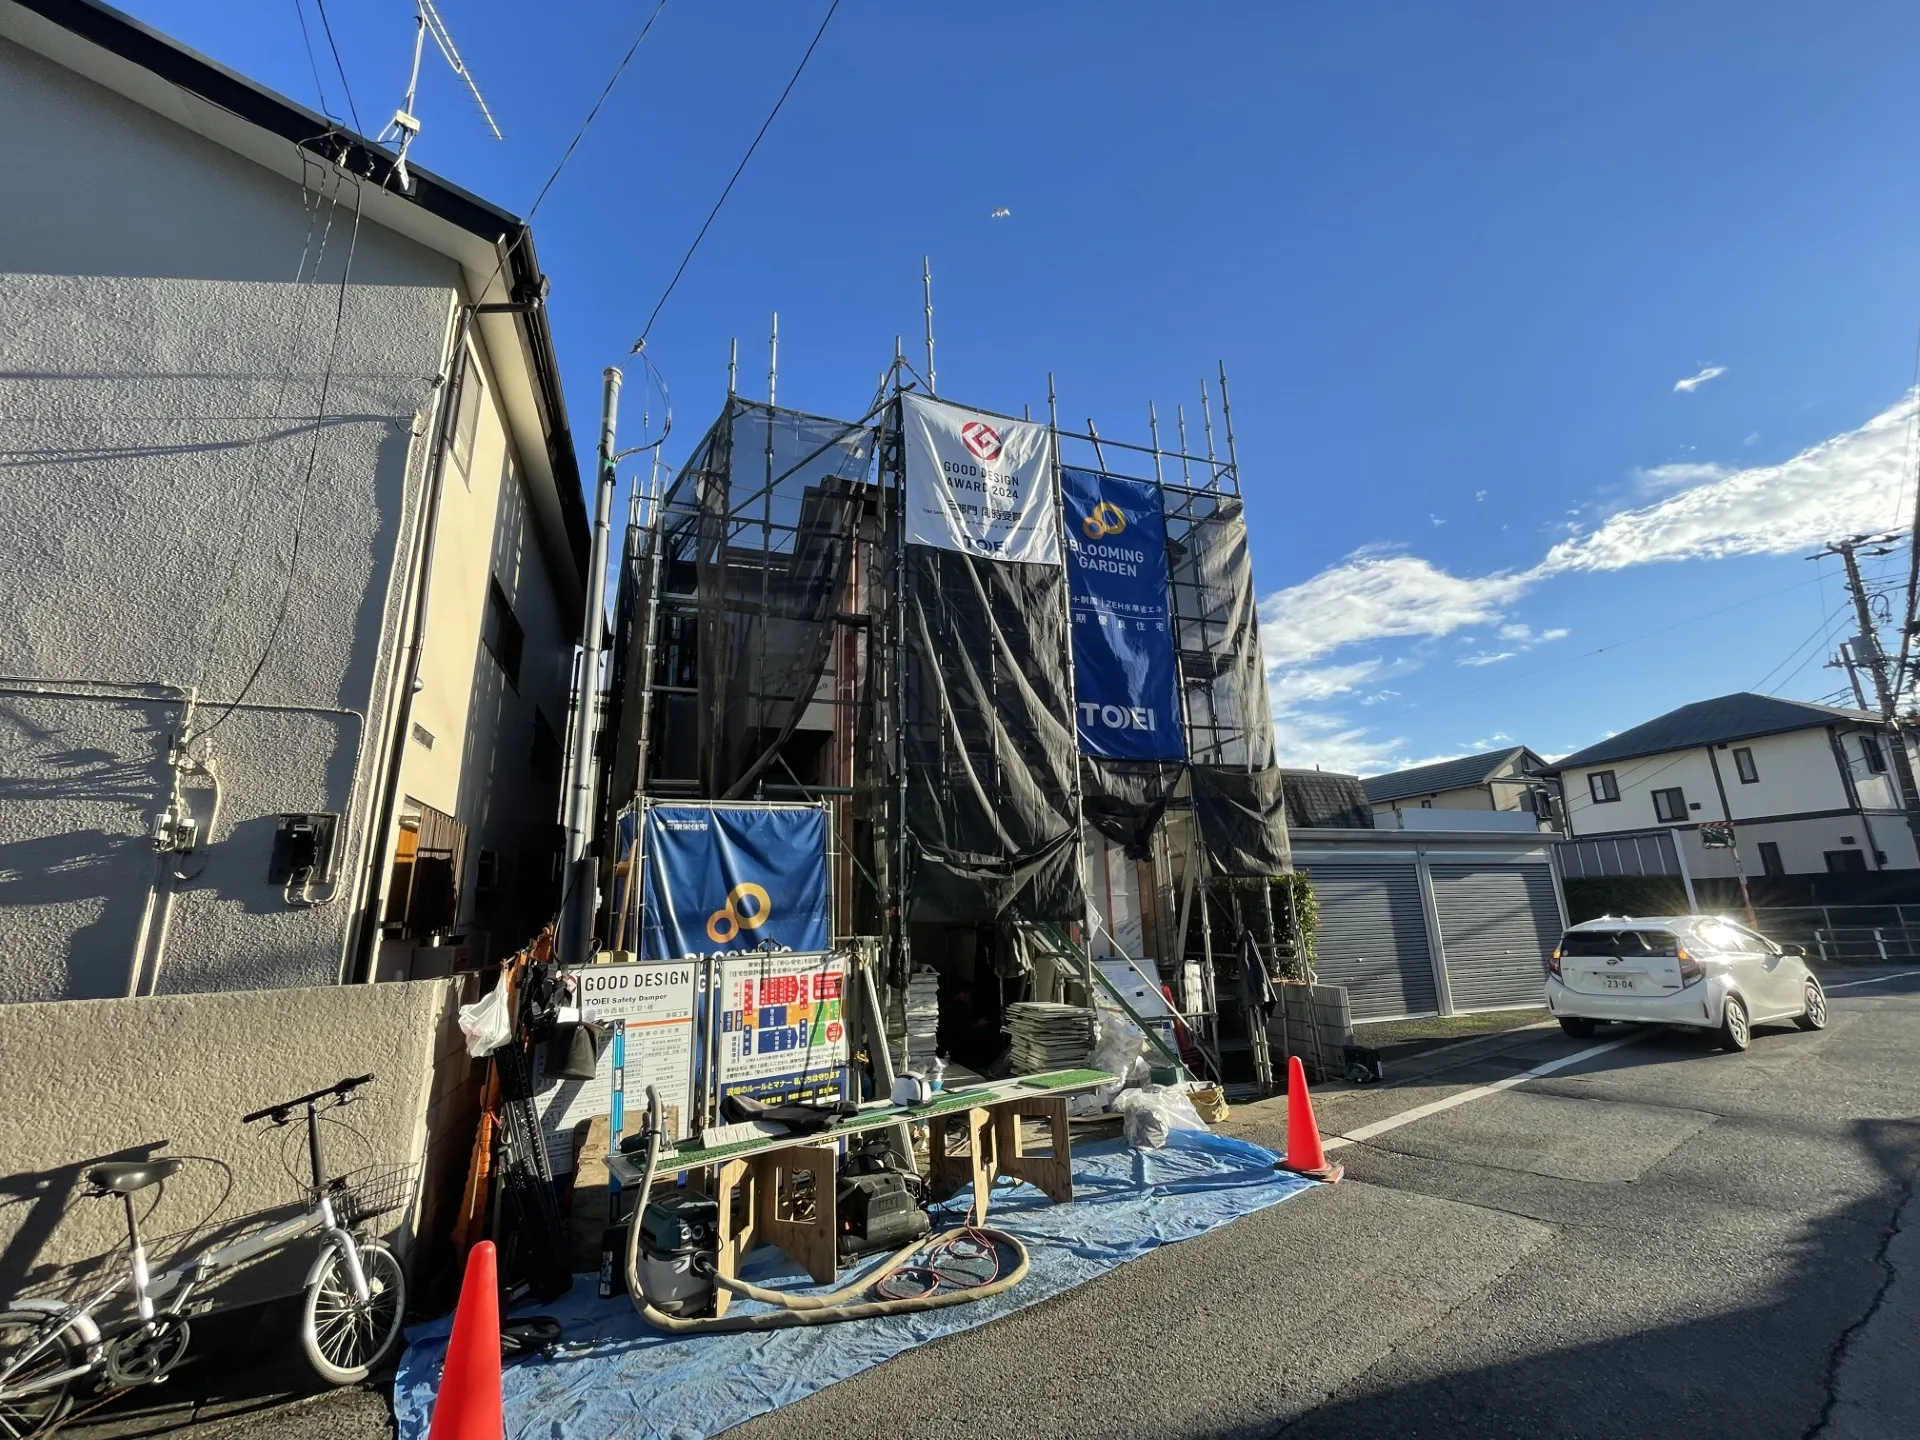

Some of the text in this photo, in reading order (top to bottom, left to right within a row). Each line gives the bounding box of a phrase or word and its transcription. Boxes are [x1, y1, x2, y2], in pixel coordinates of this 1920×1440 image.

[944, 461, 1020, 487] GOOD DESIGN
[947, 477, 1019, 499] AWARD 2024
[1070, 538, 1144, 564] BLOOMING
[1079, 556, 1137, 577] GARDEN
[585, 975, 628, 992] GOOD
[634, 971, 689, 988] DESIGN
[1607, 980, 1633, 989] 23-04
[612, 996, 636, 1004] Safety
[639, 994, 667, 1003] Damper
[727, 1080, 793, 1096] 現場のルールとマナー
[880, 1199, 897, 1210] MAX
